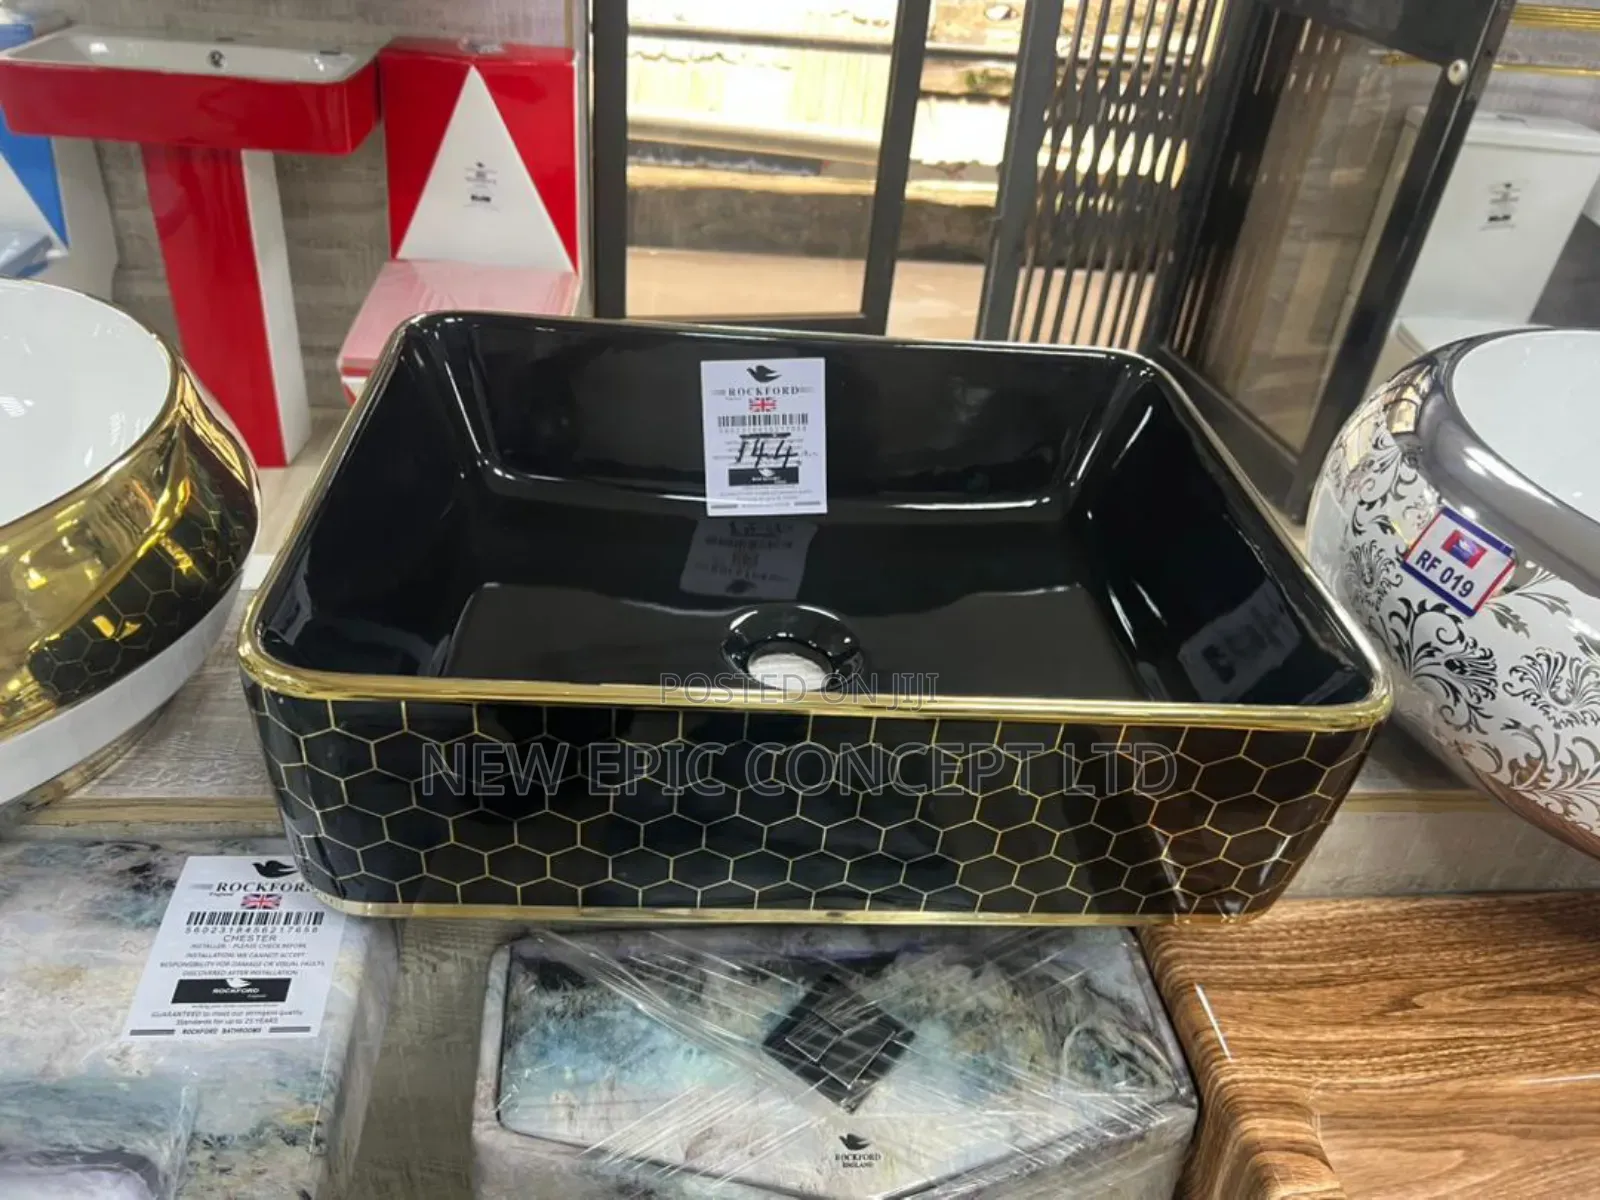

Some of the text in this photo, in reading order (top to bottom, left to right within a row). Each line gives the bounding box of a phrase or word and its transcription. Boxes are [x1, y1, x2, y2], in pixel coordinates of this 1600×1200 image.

[728, 386, 800, 397] ROCKFORD
[1416, 549, 1475, 599] RF 019
[215, 881, 311, 892] ROCKFOR
[223, 934, 278, 943] CHESTER
